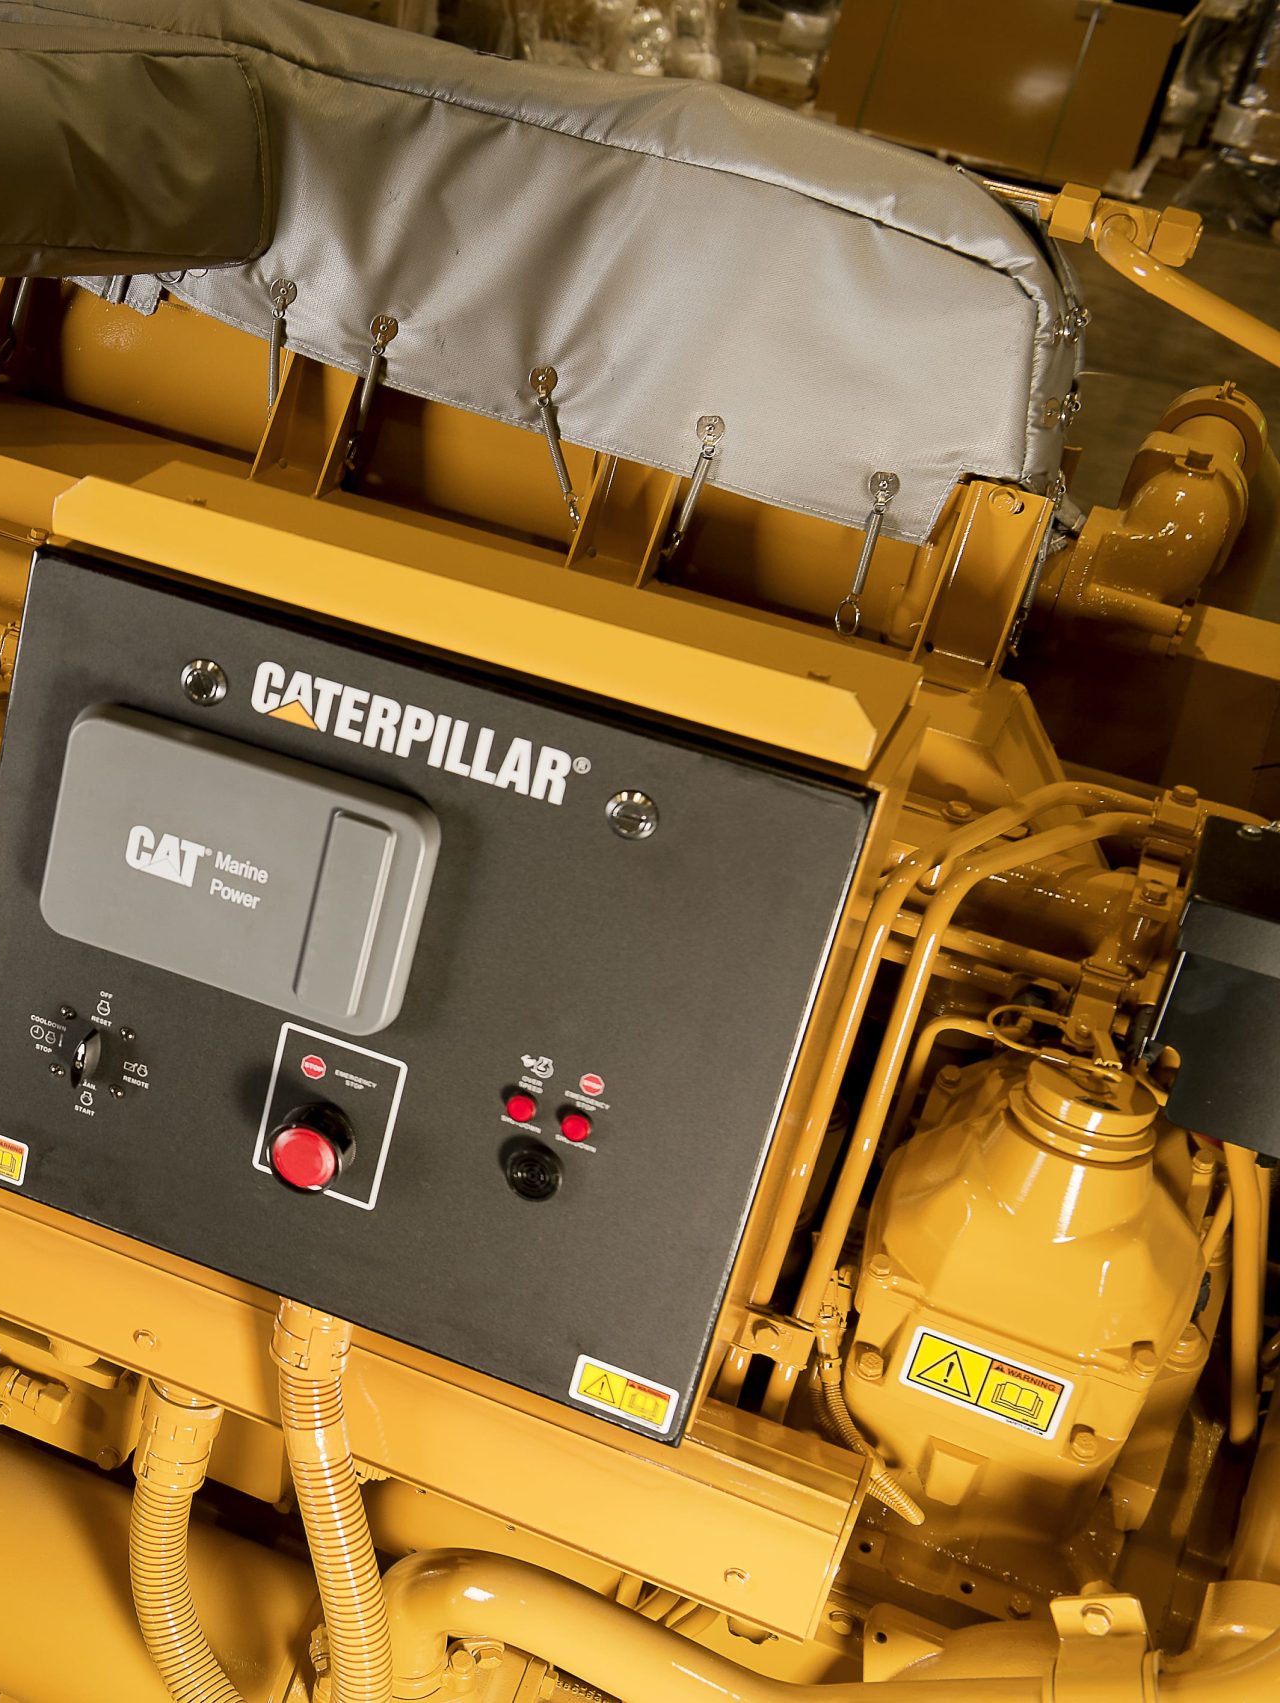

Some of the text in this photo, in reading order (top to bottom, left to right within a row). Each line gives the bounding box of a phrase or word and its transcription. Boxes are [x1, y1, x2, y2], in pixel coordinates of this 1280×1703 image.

[214, 850, 269, 885] Marine
[209, 877, 261, 910] Power
[99, 990, 113, 999] OFF
[30, 1014, 67, 1032] COOLDOWN
[91, 1015, 113, 1028] RESET
[35, 1043, 53, 1054] STOP
[303, 1061, 325, 1074] STOP
[122, 1075, 150, 1090] REMOTE
[344, 1079, 365, 1091] STOP
[74, 1104, 96, 1117] START
[1007, 1366, 1057, 1393] WARNING
